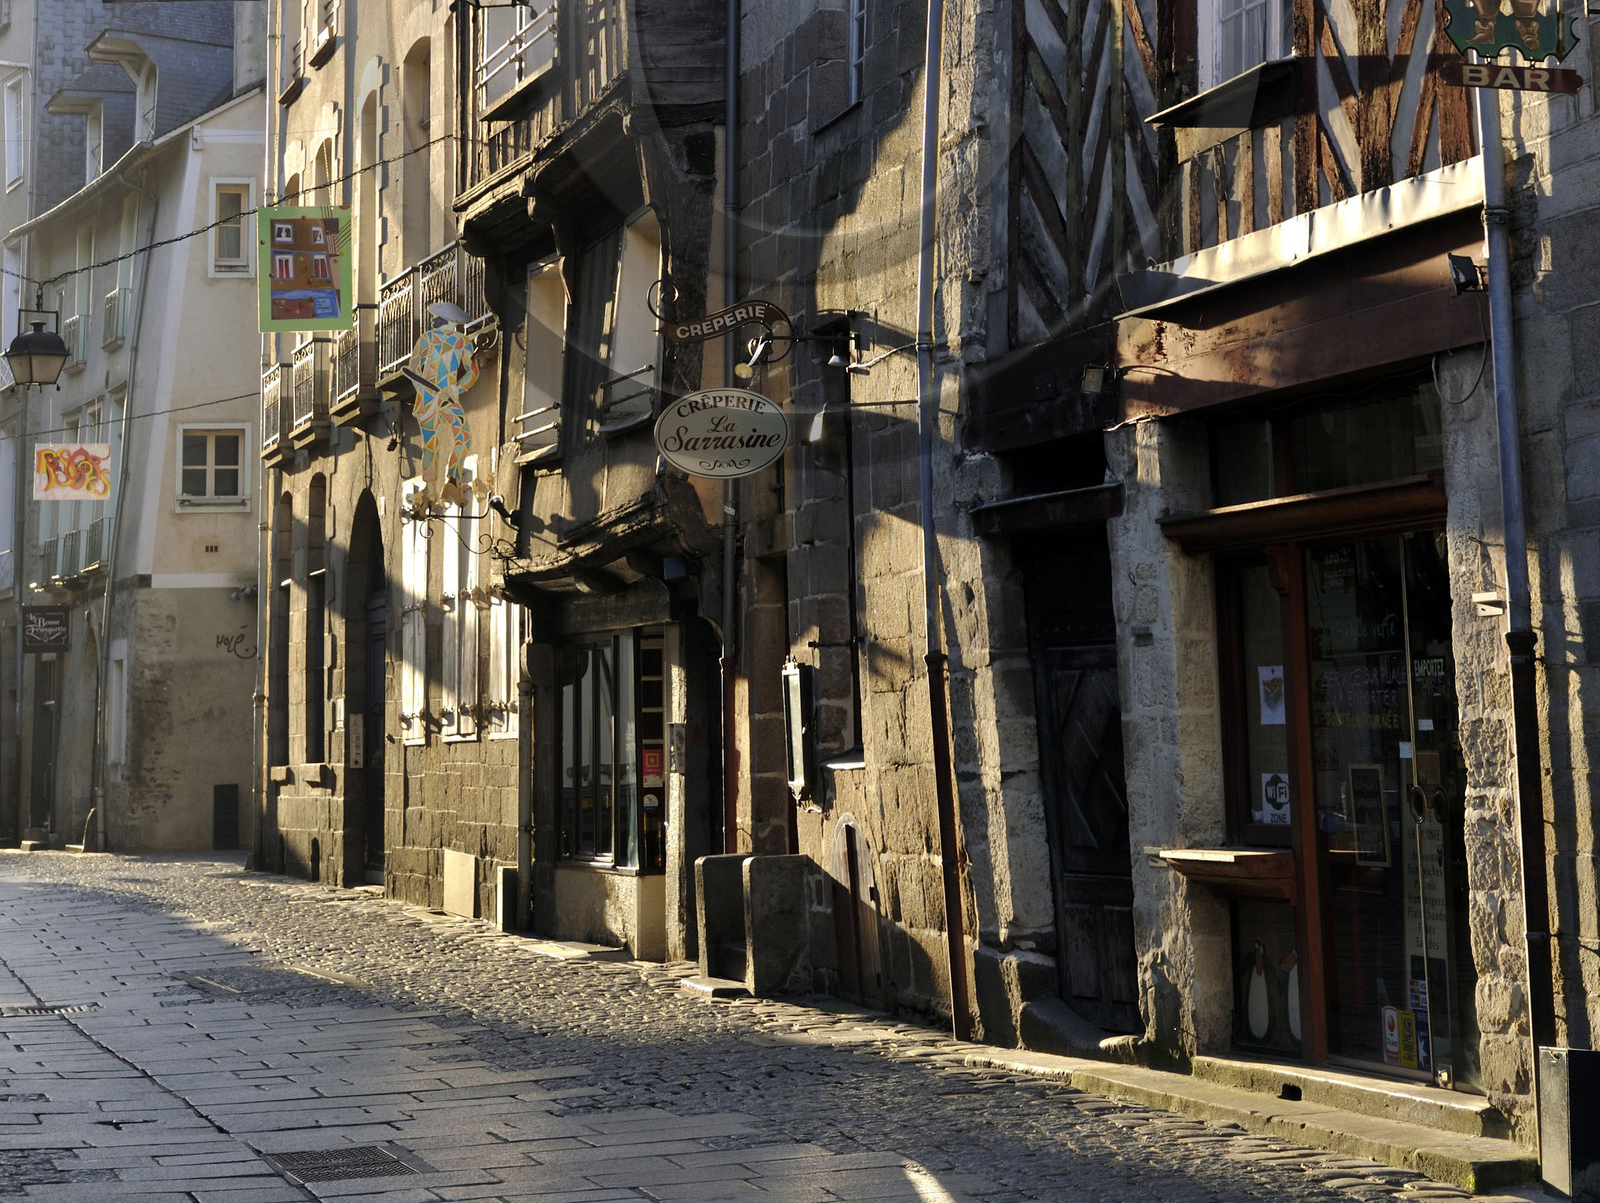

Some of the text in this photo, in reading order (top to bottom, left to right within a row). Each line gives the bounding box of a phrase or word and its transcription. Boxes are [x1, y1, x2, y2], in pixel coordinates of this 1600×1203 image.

[1462, 66, 1550, 90] BAR
[676, 306, 765, 338] CREPERIE
[677, 395, 766, 418] CRÊPERIE
[707, 415, 736, 433] La
[663, 425, 783, 453] Sarrasine
[1414, 658, 1445, 677] EMPORTEZ
[1270, 813, 1287, 823] ZONE
